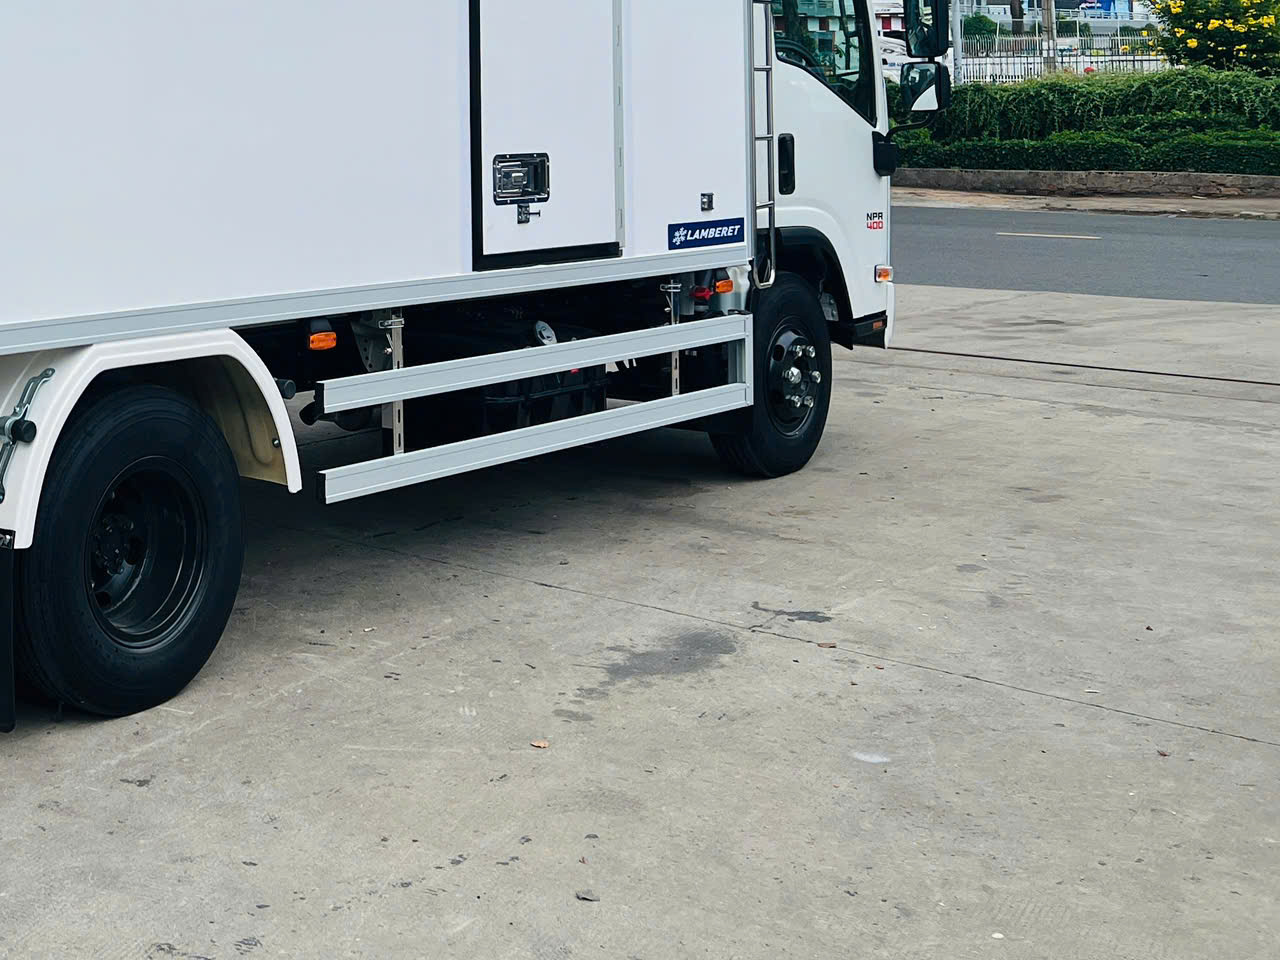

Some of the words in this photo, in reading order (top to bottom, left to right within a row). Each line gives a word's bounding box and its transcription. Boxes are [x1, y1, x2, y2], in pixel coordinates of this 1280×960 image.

[866, 212, 883, 221] NPR
[866, 221, 884, 229] 400
[686, 224, 741, 241] LAMBERET
